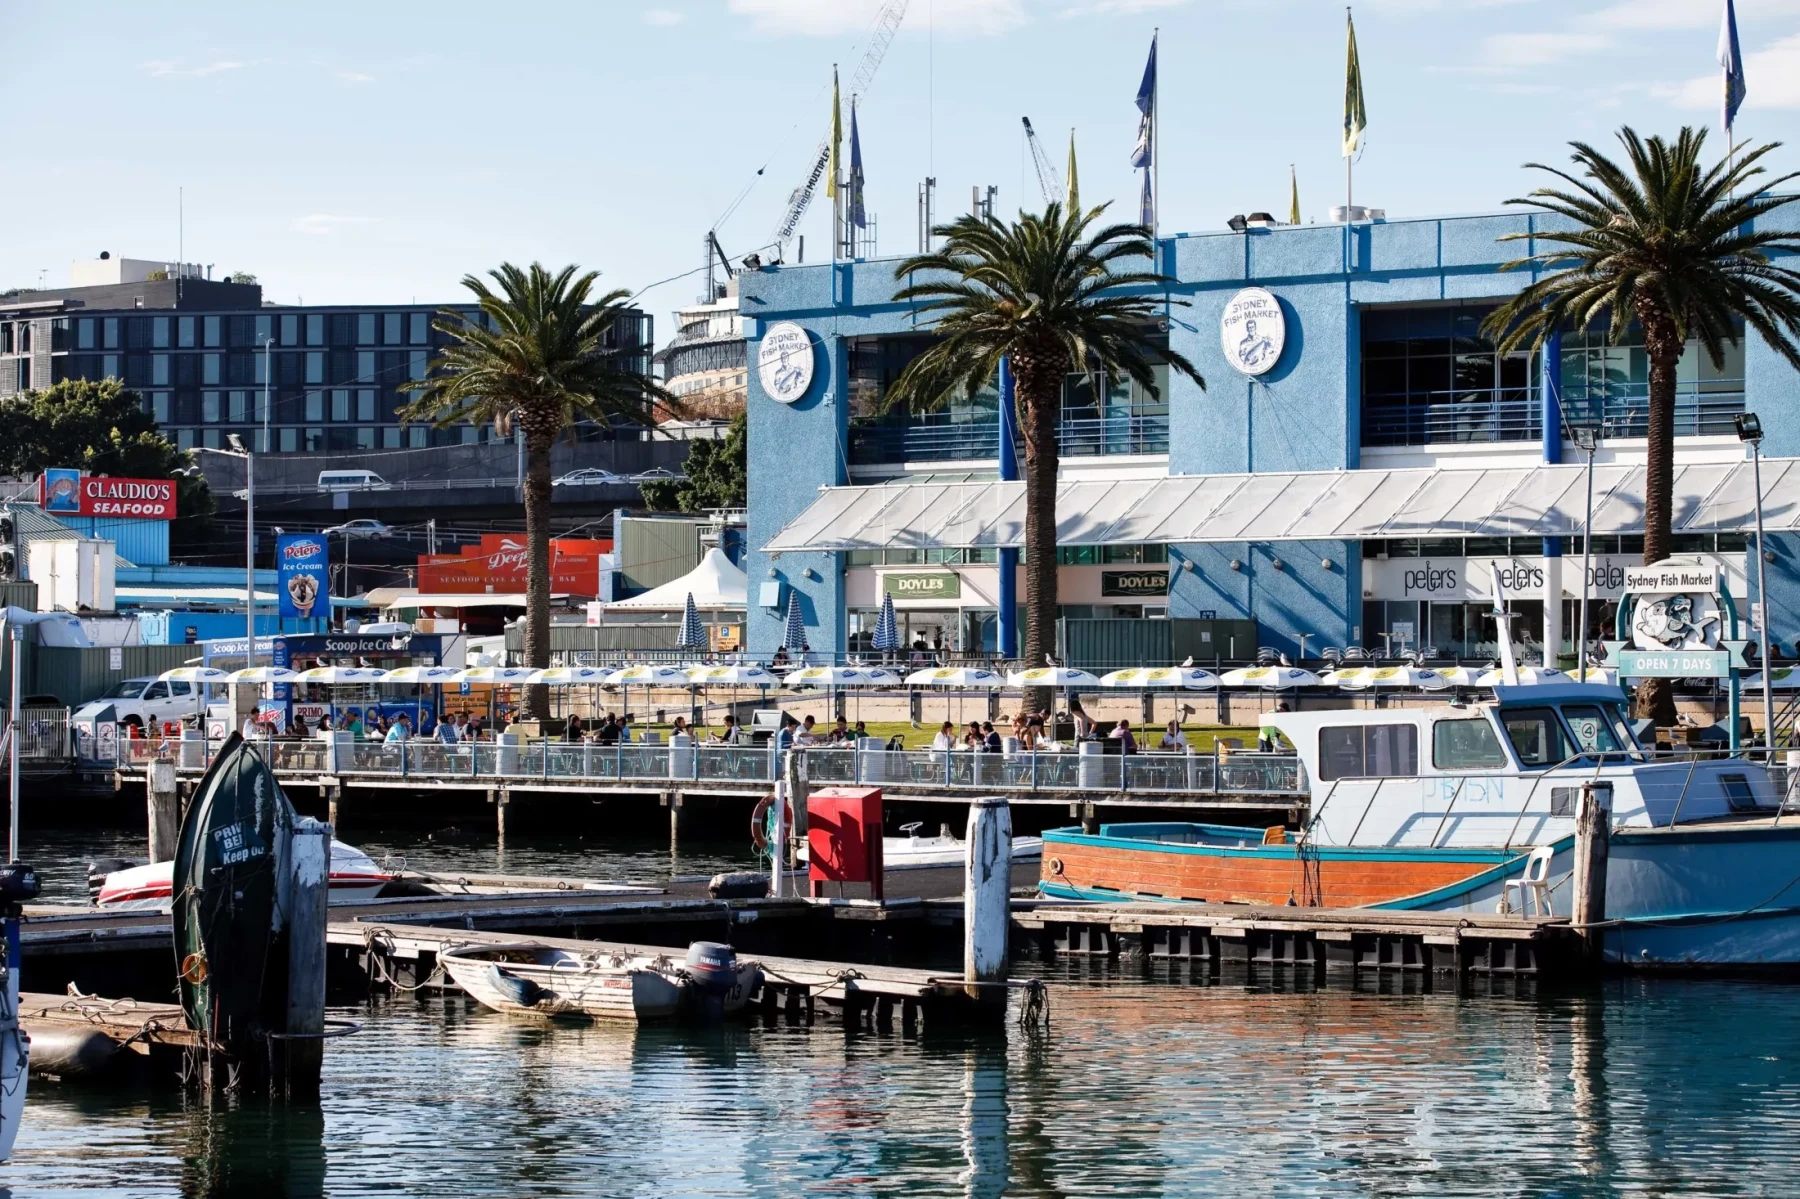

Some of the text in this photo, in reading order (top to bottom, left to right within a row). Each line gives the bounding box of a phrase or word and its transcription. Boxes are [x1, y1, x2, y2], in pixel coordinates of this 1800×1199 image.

[783, 189, 811, 237] Brookfield
[1232, 299, 1268, 314] SYDNEY
[1224, 309, 1279, 328] FISH MARKET
[768, 332, 799, 346] SYDNEY
[761, 342, 809, 359] FISH MARKET
[86, 481, 170, 501] CLAUDIO'S
[92, 502, 165, 515] SEAFOOD
[284, 544, 321, 560] Peters
[283, 562, 323, 571] Ice Cream
[898, 578, 944, 590] DOYLES
[1118, 576, 1167, 588] DOYLES
[1627, 572, 1713, 589] Sydney Fish Market
[213, 643, 236, 655] Scoop
[237, 642, 249, 652] Ice
[325, 639, 357, 653] Scoop
[359, 639, 374, 651] Ice
[1636, 658, 1712, 671] OPEN 7 DAYS
[461, 682, 469, 692] P
[297, 706, 323, 718] PRIMO
[1584, 726, 1592, 735] 4
[223, 849, 249, 865] Keep
[700, 956, 721, 967] YAMAHA
